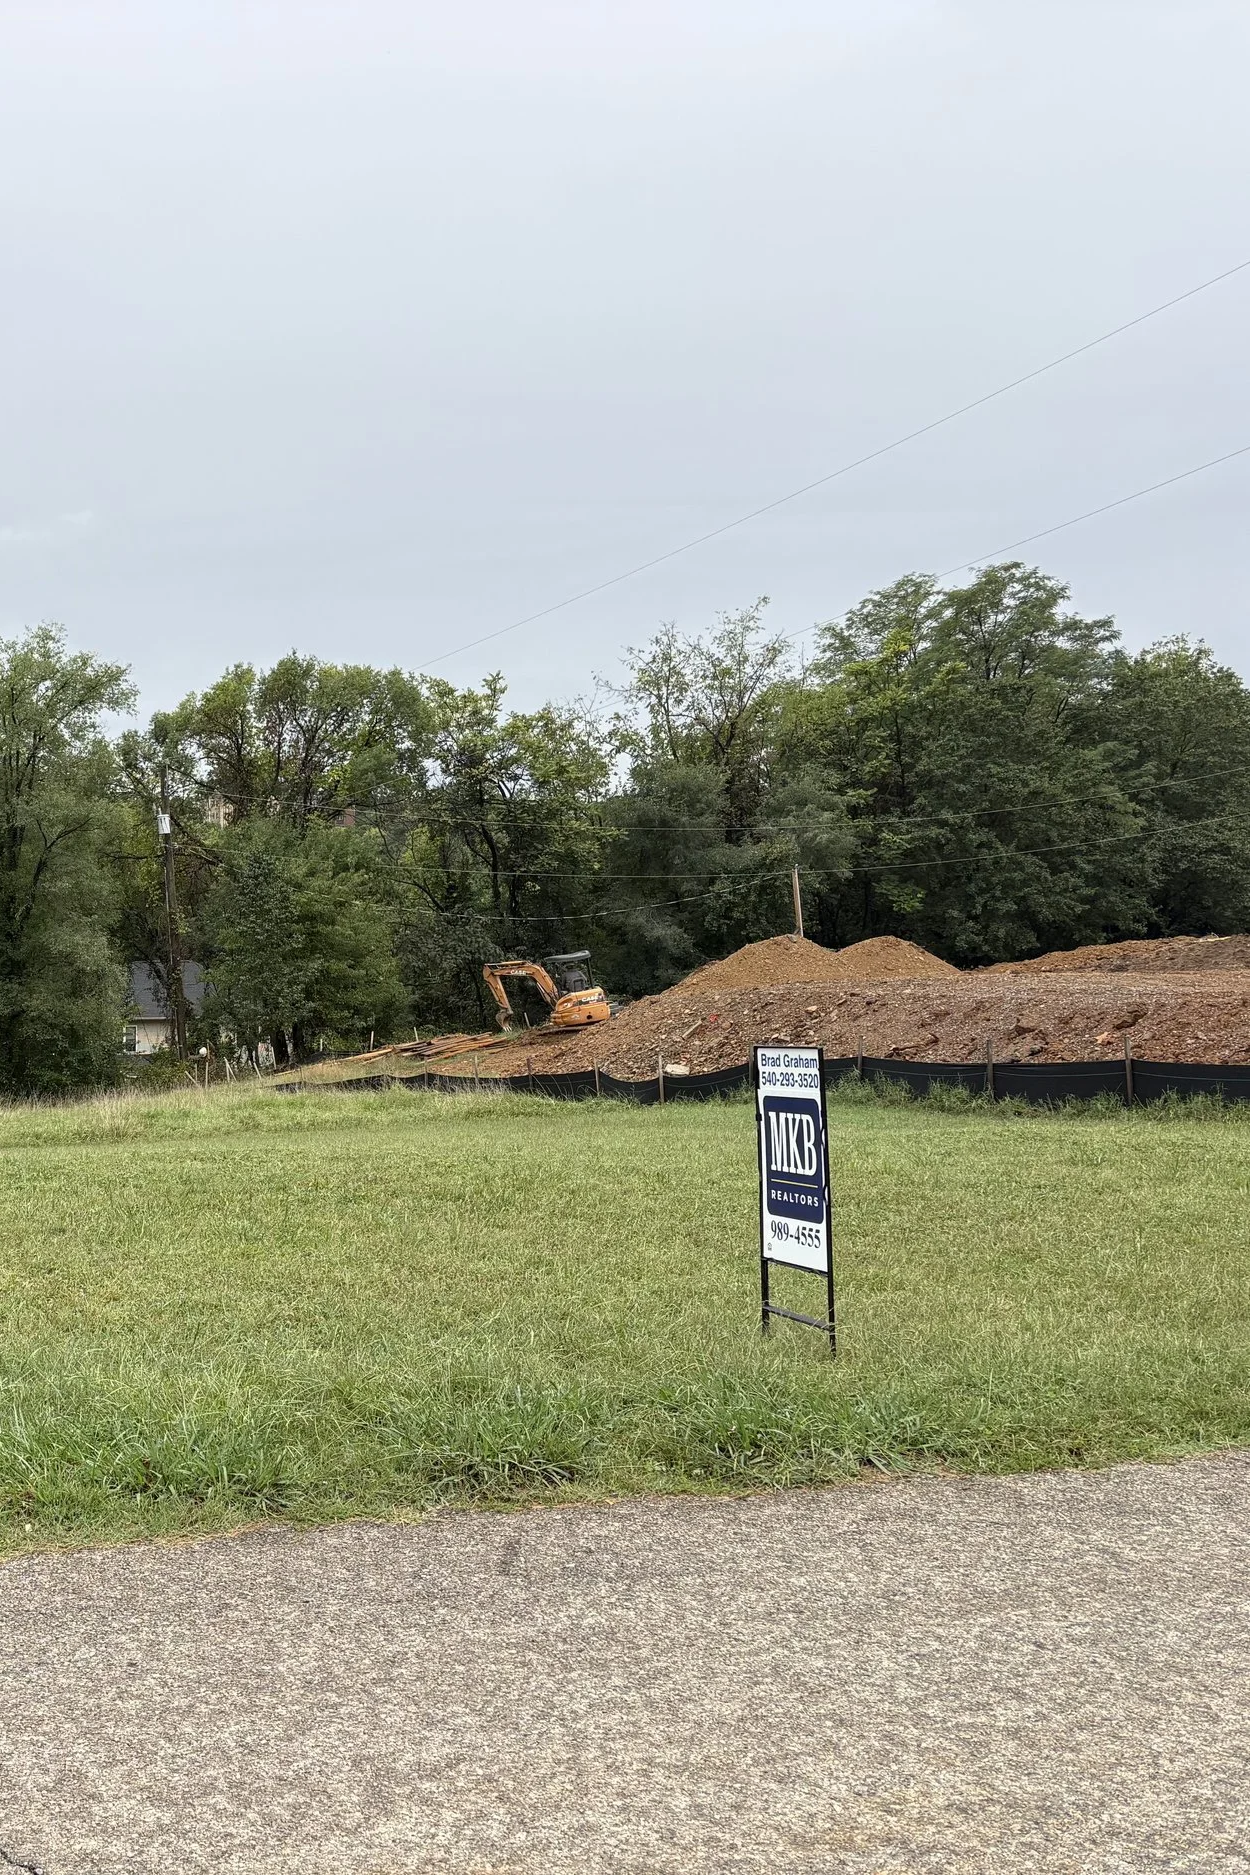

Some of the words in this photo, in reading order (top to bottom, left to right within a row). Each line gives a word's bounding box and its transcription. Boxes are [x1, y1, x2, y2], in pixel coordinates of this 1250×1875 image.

[761, 1053, 781, 1067] Brad
[783, 1054, 818, 1069] Graham
[761, 1071, 819, 1089] 540-293-3520
[768, 1111, 817, 1176] MKB
[771, 1189, 819, 1207] REALTORS
[771, 1220, 821, 1249] 989-4555
